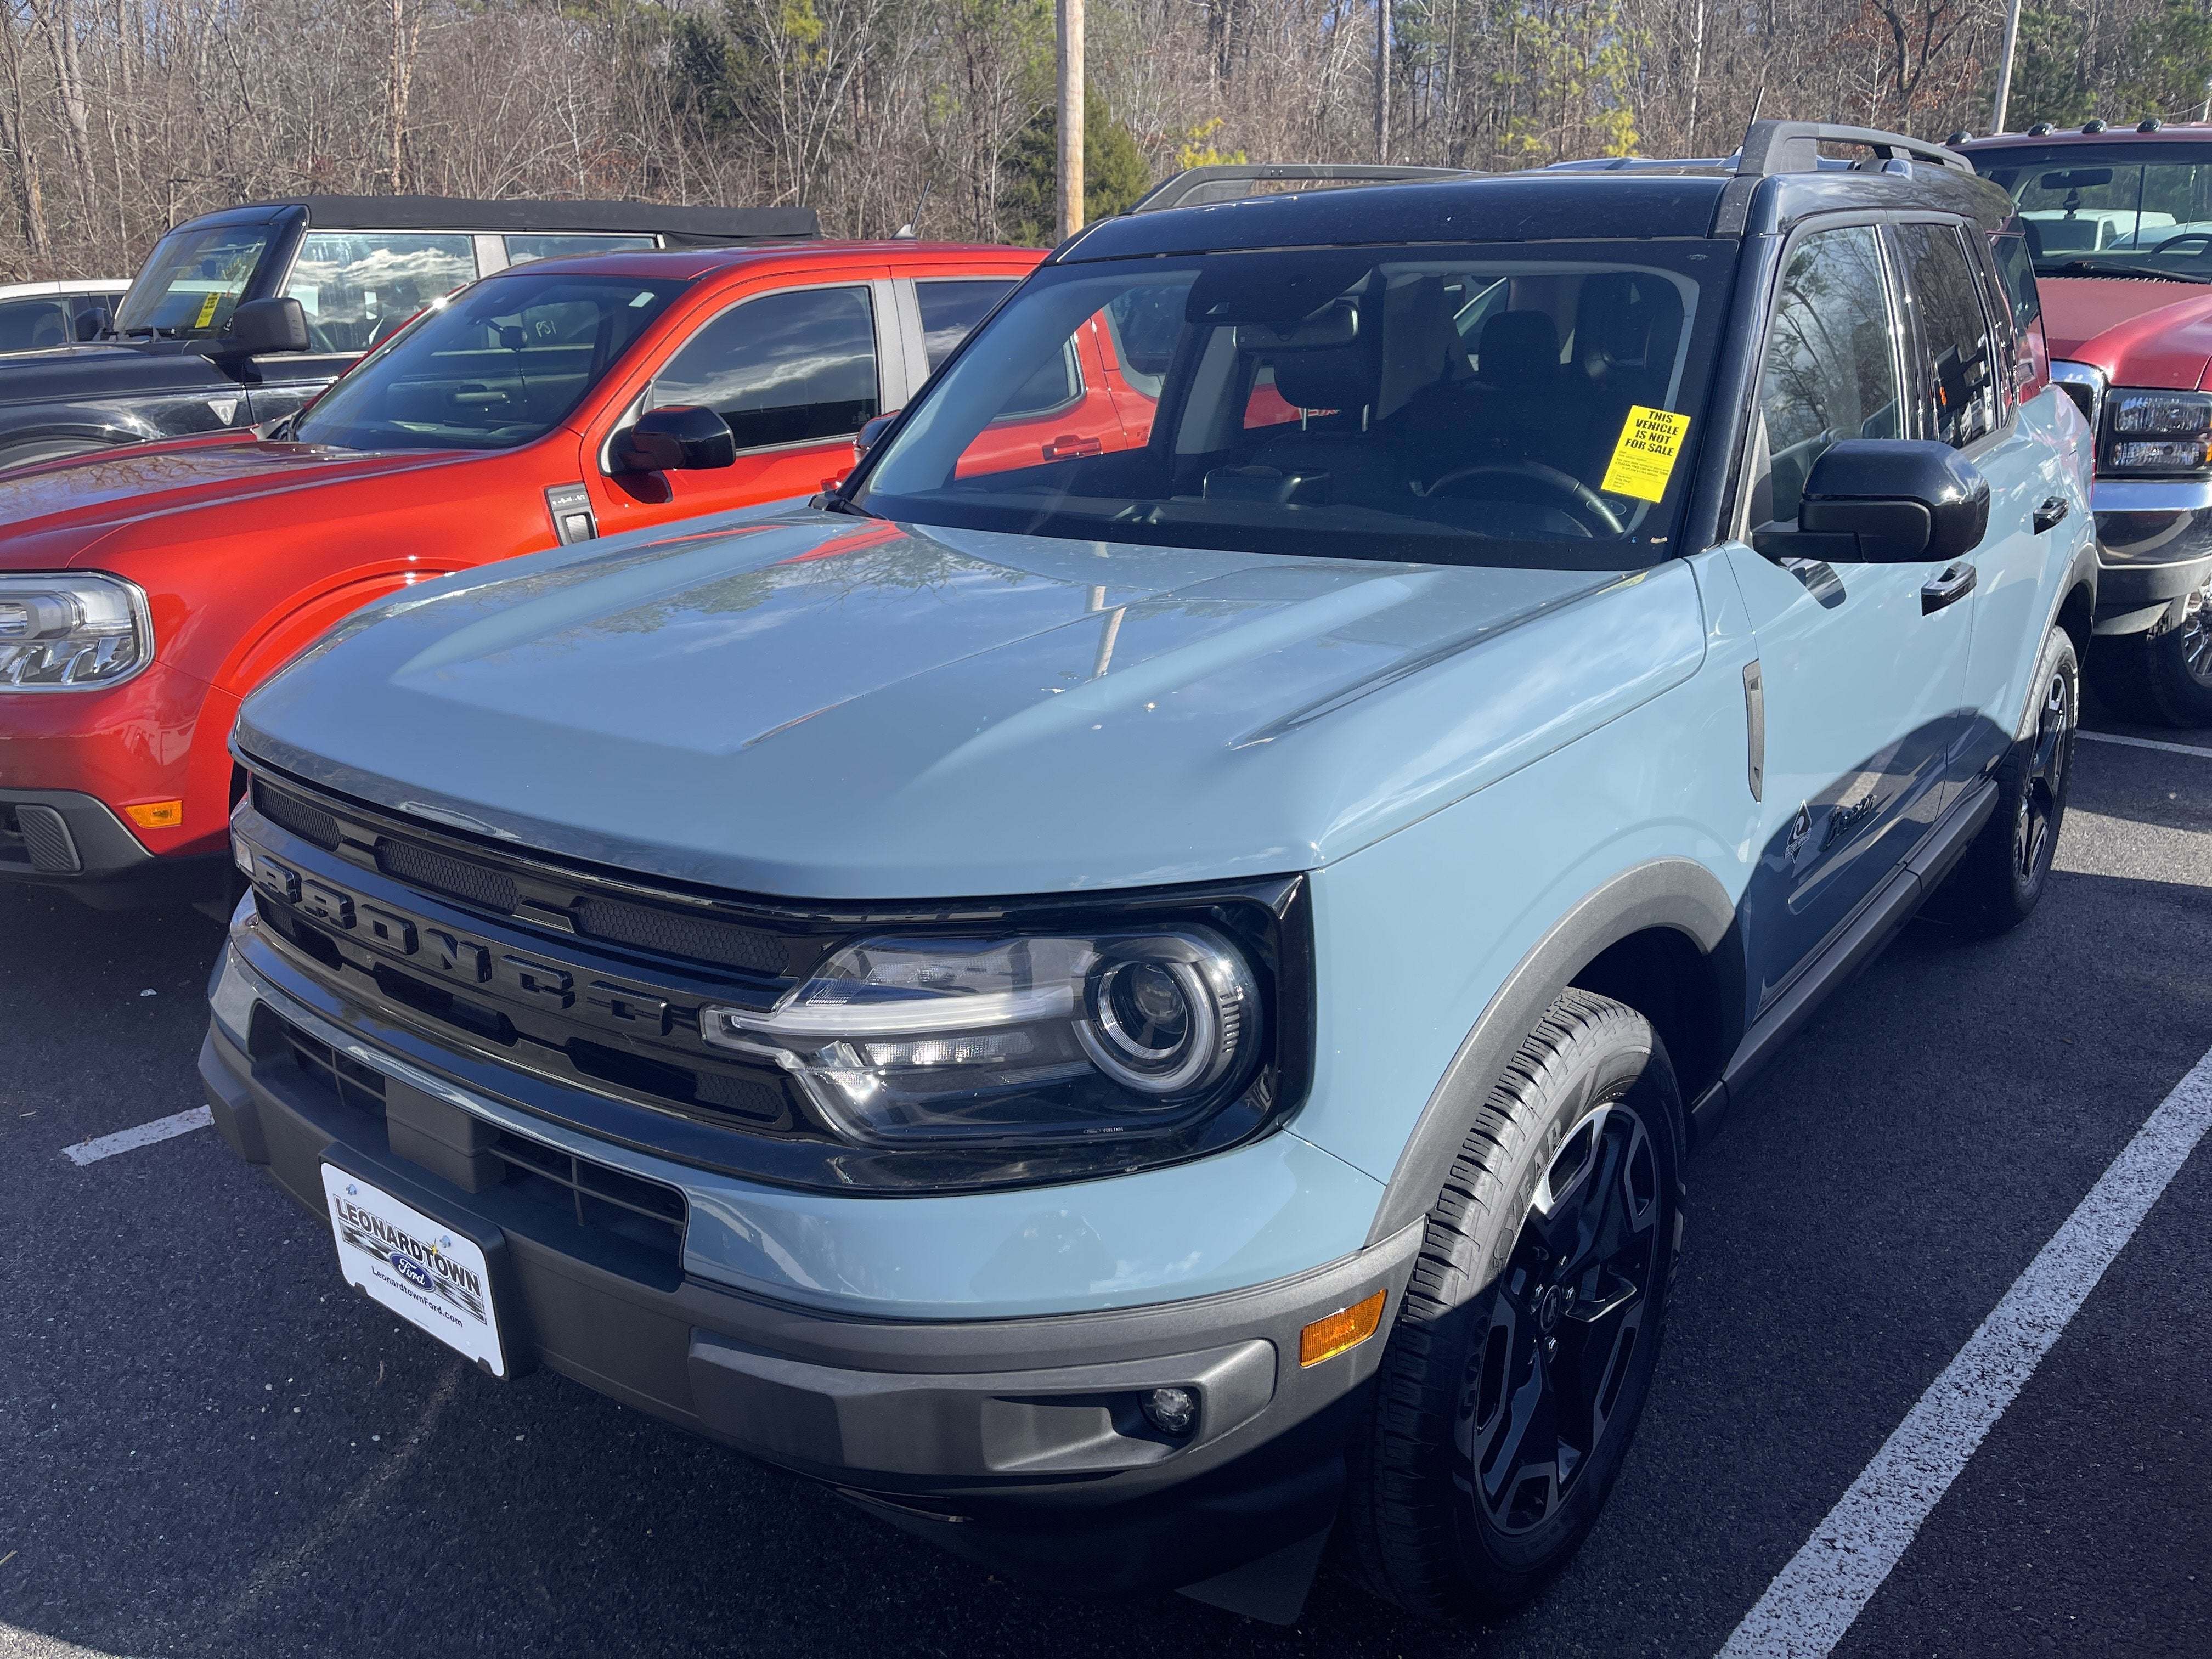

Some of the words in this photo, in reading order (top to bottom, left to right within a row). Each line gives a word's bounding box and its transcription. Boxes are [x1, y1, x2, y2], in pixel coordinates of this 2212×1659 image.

[1635, 419, 1679, 436] VEHICLE
[1649, 410, 1673, 424] THIS
[1624, 438, 1646, 450] FOR
[1647, 443, 1674, 456] SALE
[1635, 430, 1647, 439] IS
[1648, 432, 1672, 444] NOT
[256, 855, 672, 1037] BRONCO
[333, 1194, 483, 1299] LEONARDTOWN
[398, 1258, 426, 1285] Ford
[371, 1266, 463, 1328] LeonardtownFord.com
